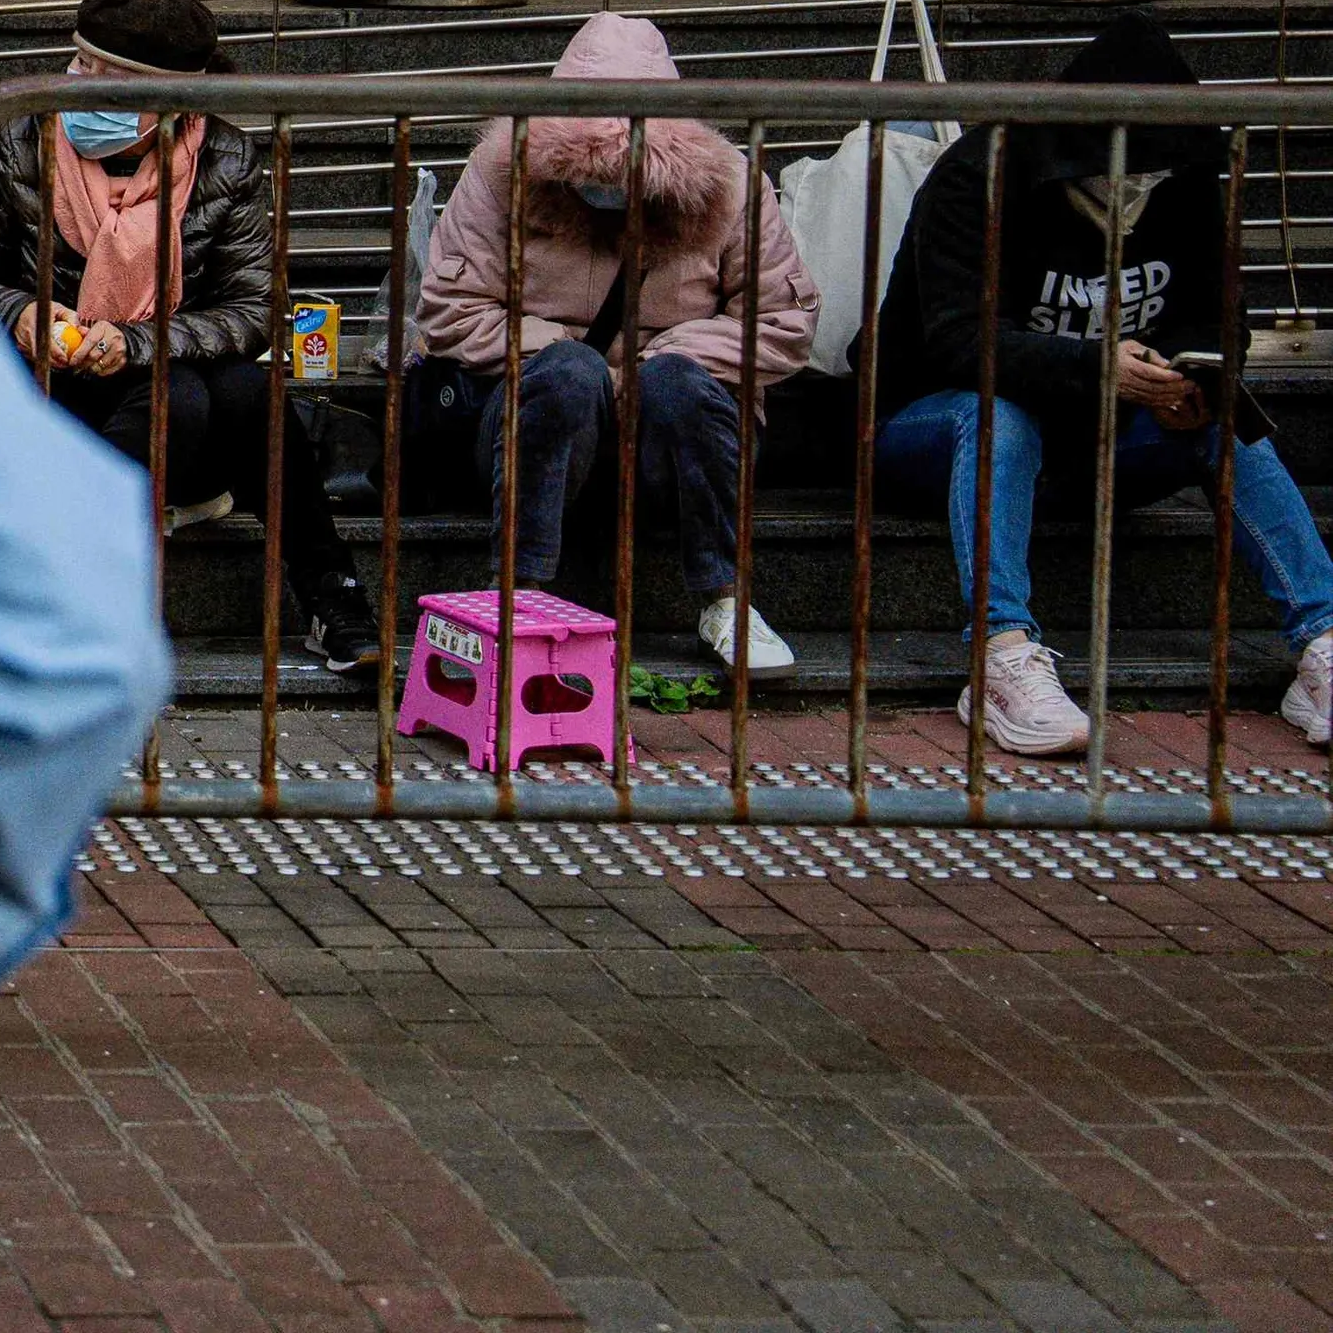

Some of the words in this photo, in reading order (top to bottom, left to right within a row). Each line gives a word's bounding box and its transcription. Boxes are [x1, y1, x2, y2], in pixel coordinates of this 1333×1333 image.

[1040, 270, 1058, 304] I
[1058, 260, 1171, 308] NEED
[1027, 295, 1166, 340] SLEEP
